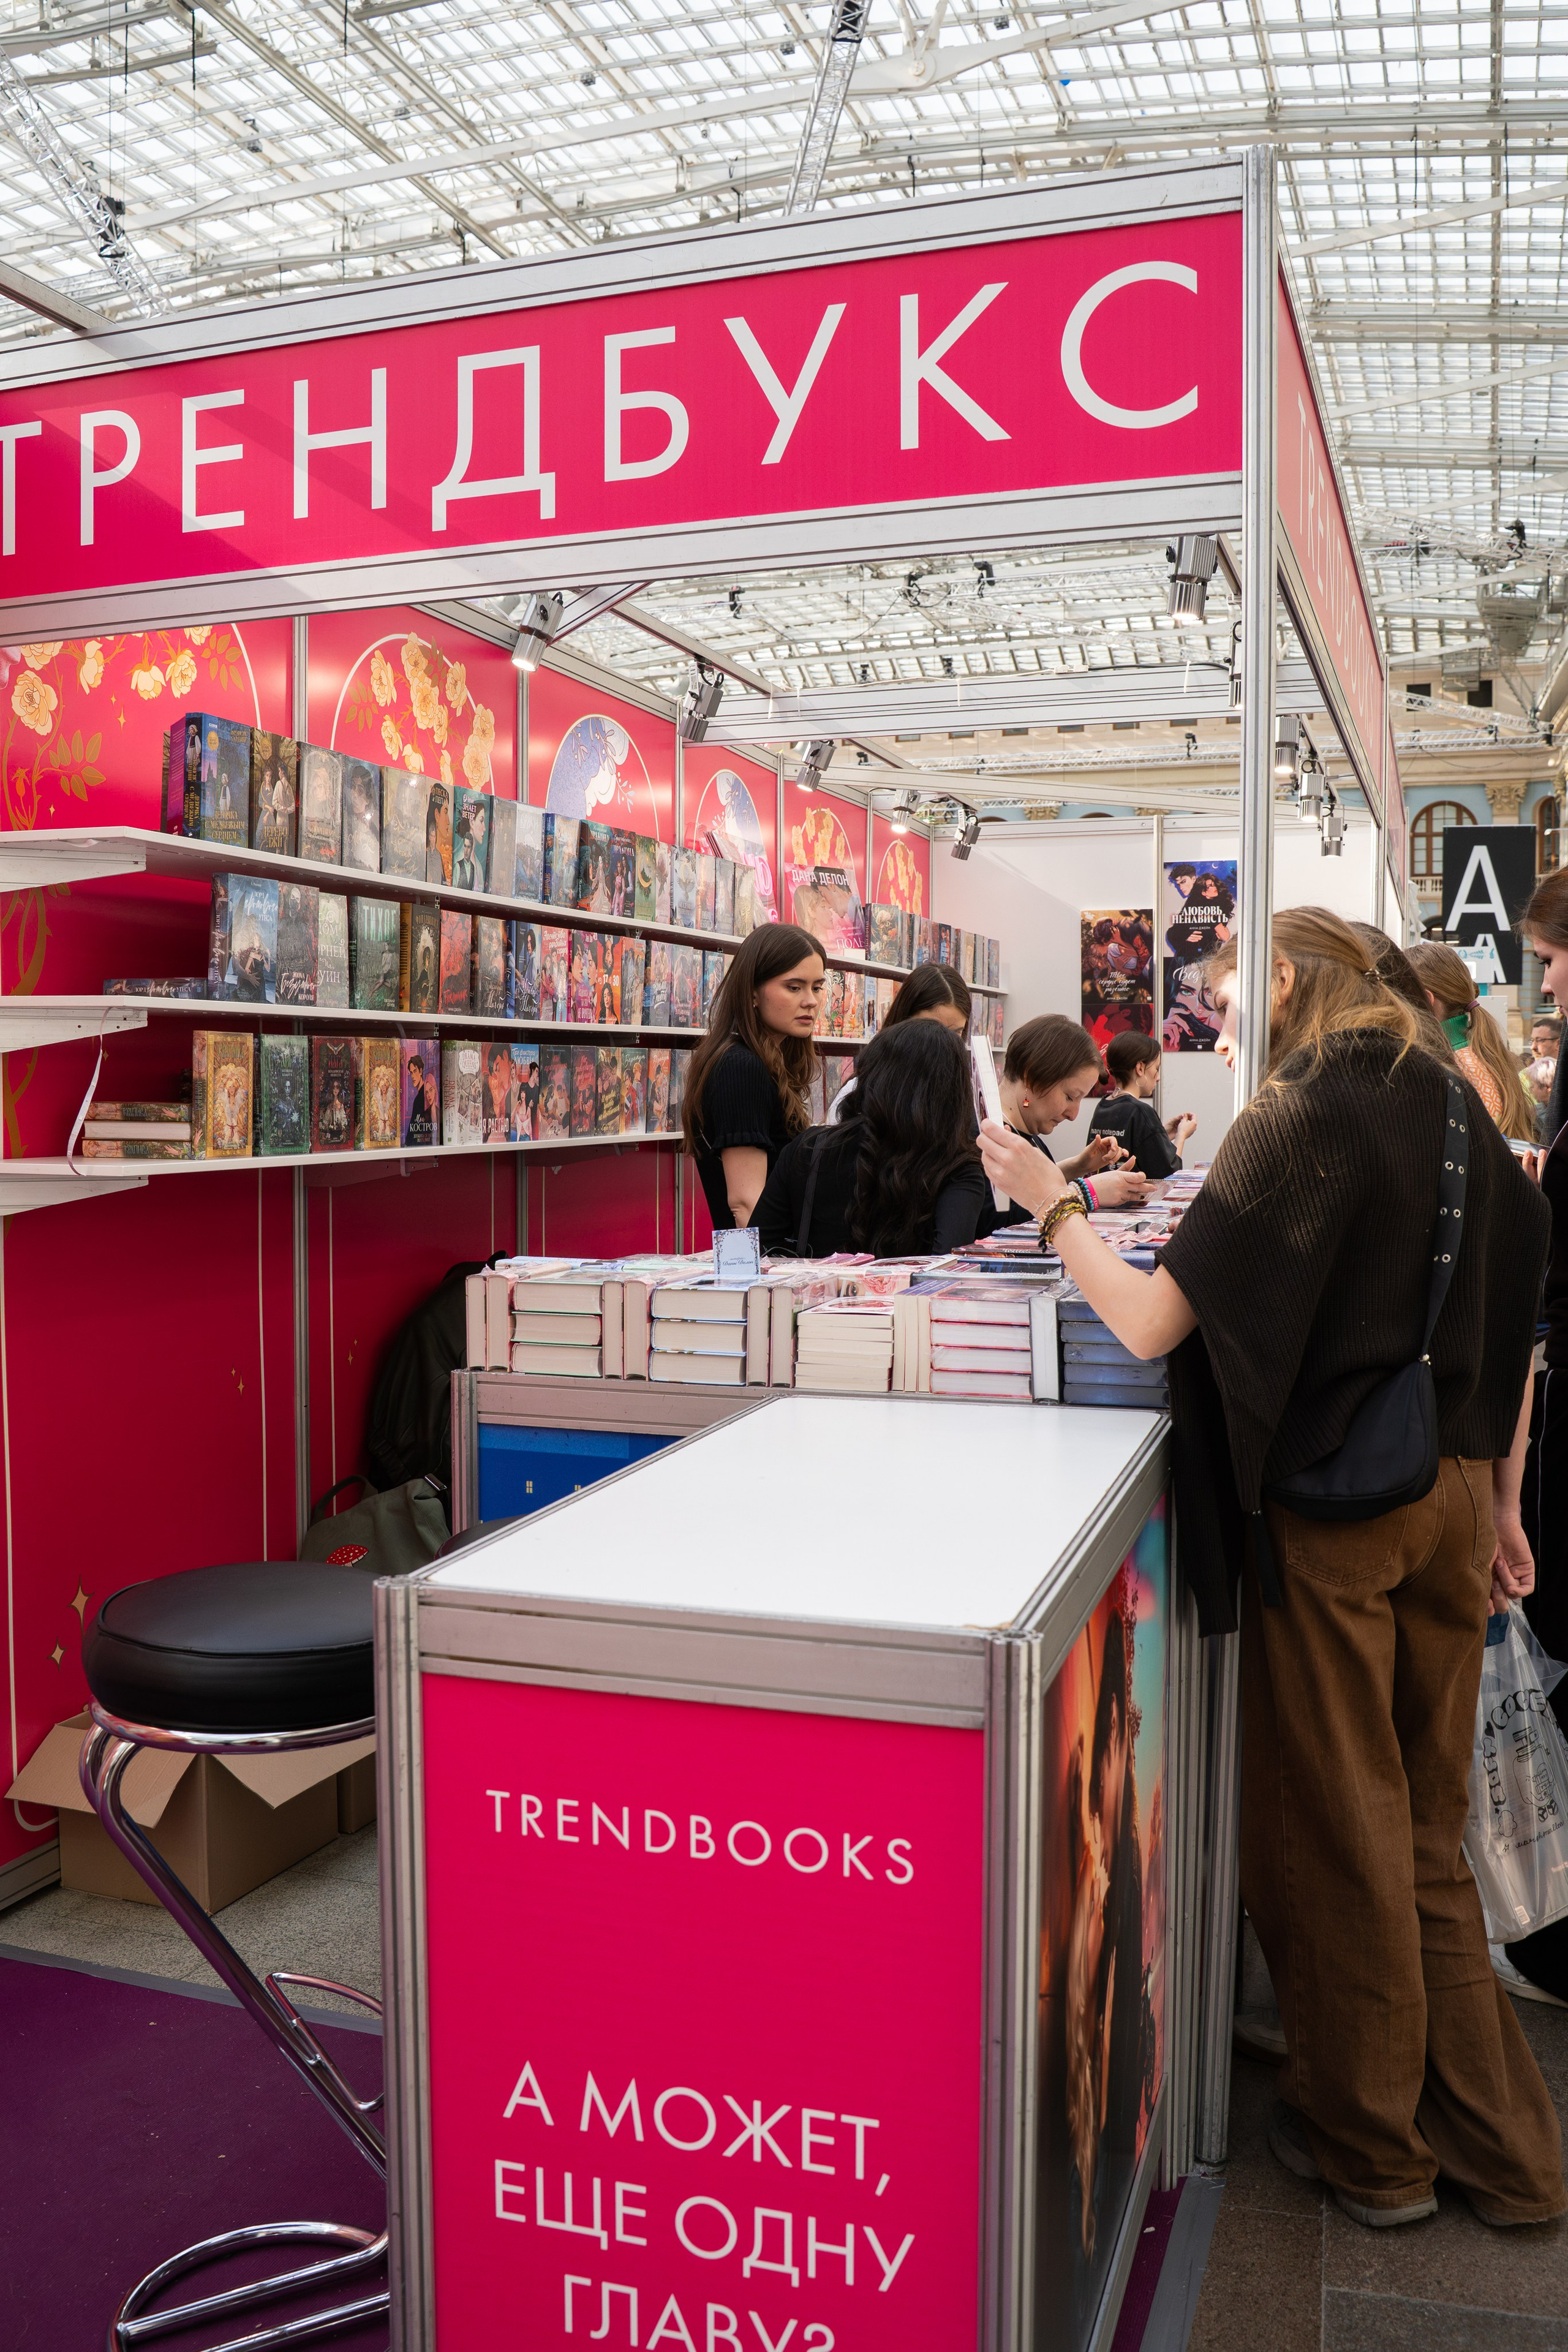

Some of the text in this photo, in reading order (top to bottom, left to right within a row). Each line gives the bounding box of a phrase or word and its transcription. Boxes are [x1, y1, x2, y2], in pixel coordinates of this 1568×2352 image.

[0, 261, 1199, 556] ТРЕНДБУКС
[1297, 390, 1374, 749] TRENDBOOKS
[462, 802, 477, 813] ЗНАЕТ
[214, 810, 238, 820] ДЕВОЧКА
[462, 811, 475, 820] ВЕТЕР
[209, 820, 245, 830] МЕДВЕЖЬИМ
[211, 830, 238, 840] СЕРДЦЕМ
[262, 826, 288, 837] ДЕРЕВО
[266, 837, 283, 848] ЛЖИ
[792, 869, 850, 886] ДАНА ДЕЛОН
[1182, 906, 1223, 916] ЛЮБОВЬ
[1171, 913, 1229, 924] НЕНАВИСТЬ
[363, 905, 397, 944] ТИХОЕ
[543, 930, 566, 941] Агентство
[317, 970, 341, 987] УИН
[603, 974, 609, 985] 17
[612, 974, 619, 987] 30
[298, 993, 314, 1001] КОРОЛЯ
[462, 1052, 477, 1061] DRAMA
[519, 1048, 537, 1058] фактора
[462, 1060, 478, 1069] QUEENS
[513, 1057, 535, 1066] ЛЮБВИ
[123, 1107, 148, 1117] КРАПИВА
[410, 1122, 437, 1132] КОСТРОВ
[483, 1118, 509, 1134] Я РАСТАЮ
[124, 1144, 150, 1155] КРАПИВА
[486, 1789, 914, 1885] TRENDBOOKS
[502, 2059, 891, 2197] А МОЖЕТ,
[494, 2158, 916, 2293] ЕЩЕ ОДНУ
[564, 2273, 836, 2352] ГЛАВУ?
